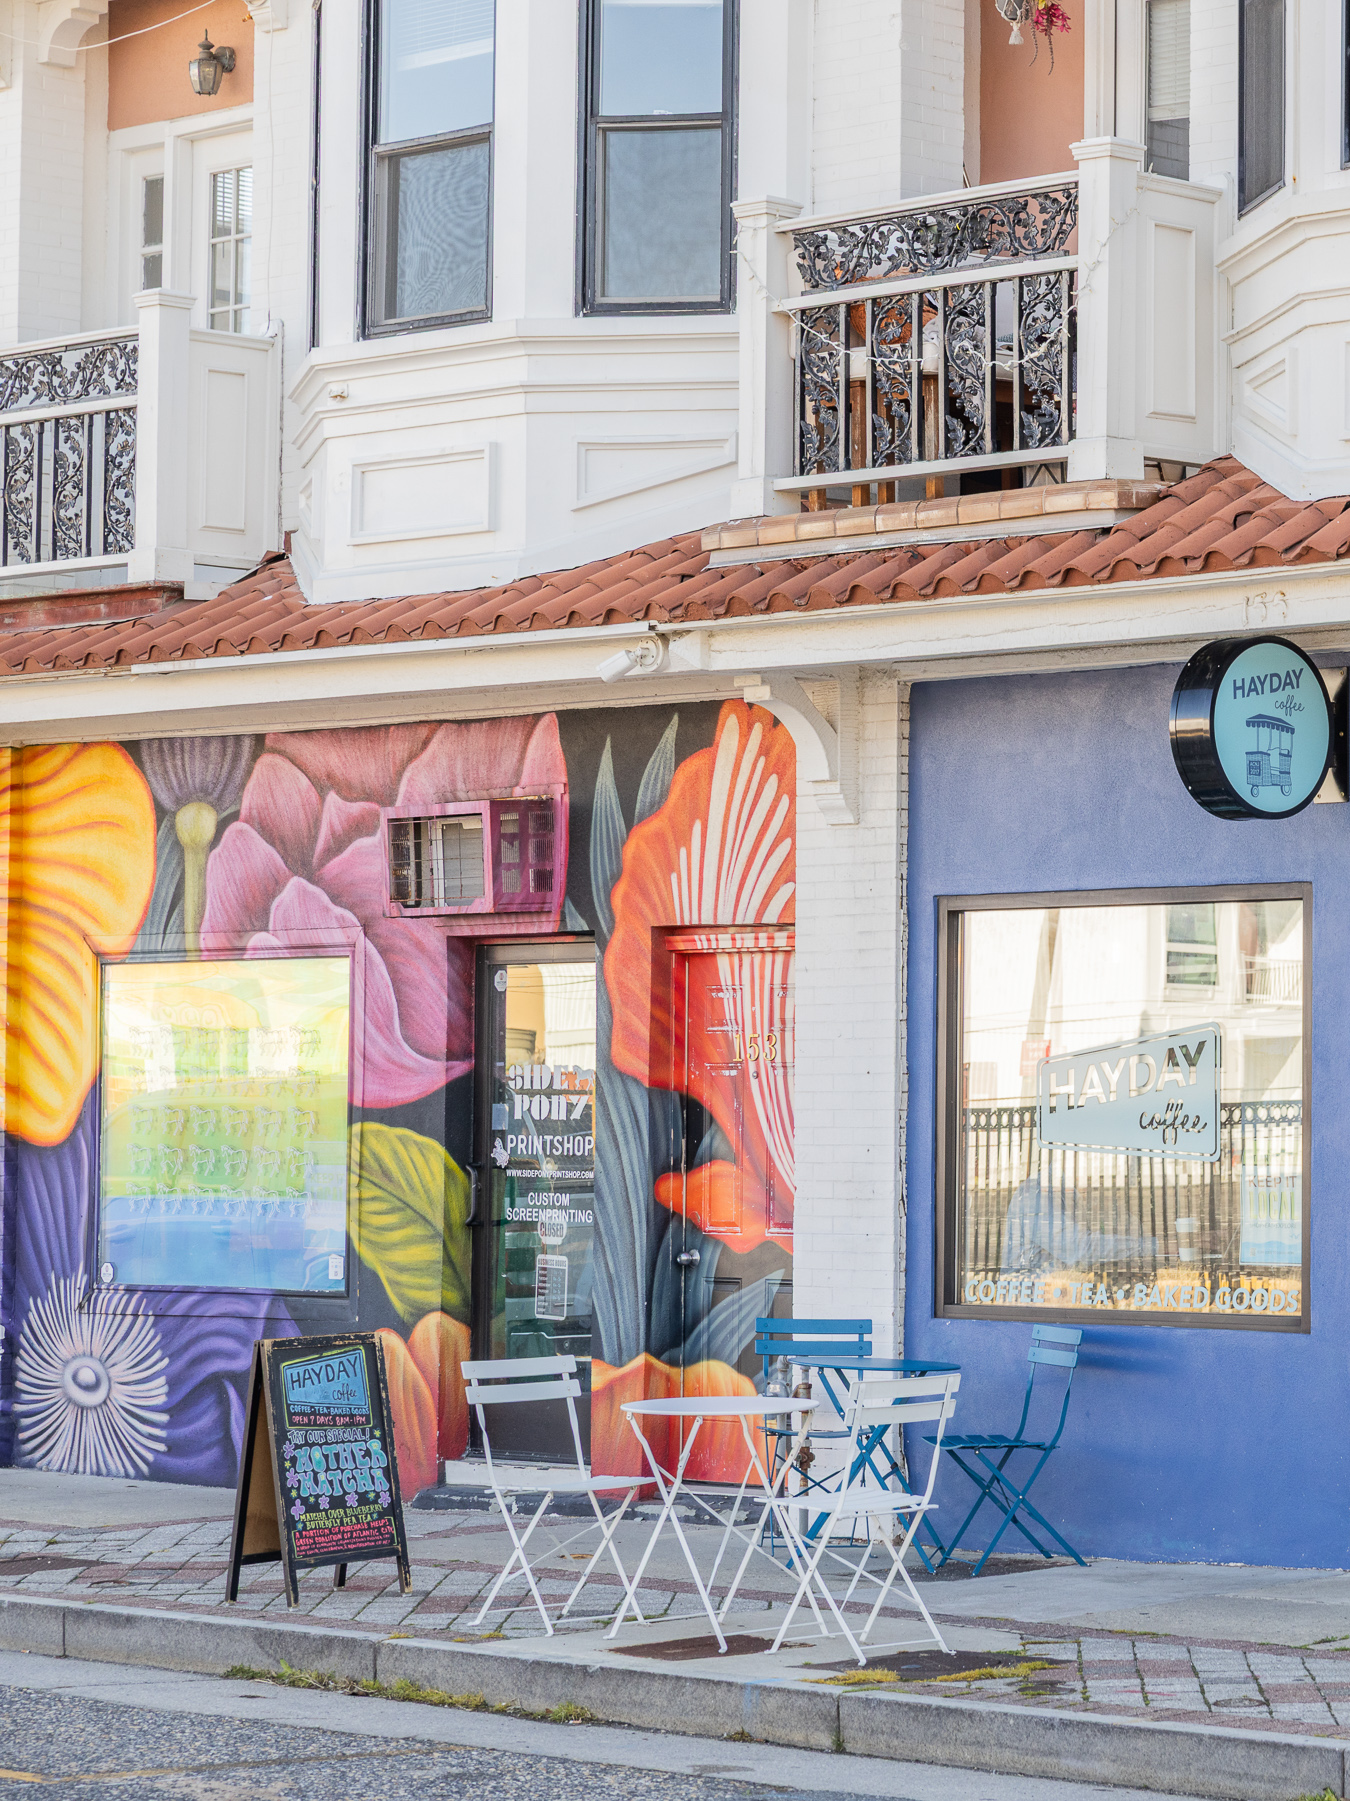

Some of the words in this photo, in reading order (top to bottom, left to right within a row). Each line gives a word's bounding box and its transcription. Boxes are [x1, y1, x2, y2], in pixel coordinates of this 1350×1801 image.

[1232, 668, 1304, 699] HAYDAY
[1275, 694, 1305, 716] coffee
[732, 1033, 777, 1062] 153
[508, 1064, 569, 1090] SIDE
[1049, 1040, 1207, 1114] HAYDAY
[1139, 1098, 1207, 1145] coffee
[507, 1134, 595, 1156] PRINTSHOP
[506, 1169, 594, 1178] WWW.SIDEPONYPRINTSHOP.COM
[1248, 1175, 1282, 1188] KEEP
[1286, 1175, 1297, 1188] IT
[527, 1192, 570, 1206] CUSTOM
[1249, 1191, 1298, 1220] LOCAL
[506, 1208, 593, 1223] SCREENPRINTING
[539, 1222, 564, 1238] CLOSED
[964, 1279, 1046, 1304] COFFEE
[1069, 1282, 1110, 1306] TEA
[1133, 1284, 1209, 1308] BAKED
[1214, 1287, 1300, 1313] GOODS
[290, 1356, 358, 1391] HAYDAY
[332, 1383, 357, 1401] coffee
[289, 1405, 312, 1413] COFFEE
[330, 1407, 351, 1415] BAKED
[316, 1416, 334, 1425] DAYS
[287, 1430, 306, 1444] TRY
[307, 1430, 326, 1444] OUR
[294, 1439, 388, 1472] MOTHER
[297, 1467, 390, 1497] MATCHA
[300, 1511, 328, 1522] MATCHA
[327, 1509, 346, 1519] OVER
[345, 1503, 384, 1516] BLUEBERRY
[305, 1518, 341, 1530] BUTTERFLY
[343, 1517, 358, 1526] PEA
[358, 1513, 373, 1523] TEA
[295, 1537, 314, 1546] GREEN
[315, 1533, 343, 1543] COALITION
[352, 1528, 379, 1538] ATLANTIC
[302, 1527, 331, 1538] PORTION
[340, 1522, 369, 1532] PURCHASE
[370, 1518, 389, 1527] HELPS
